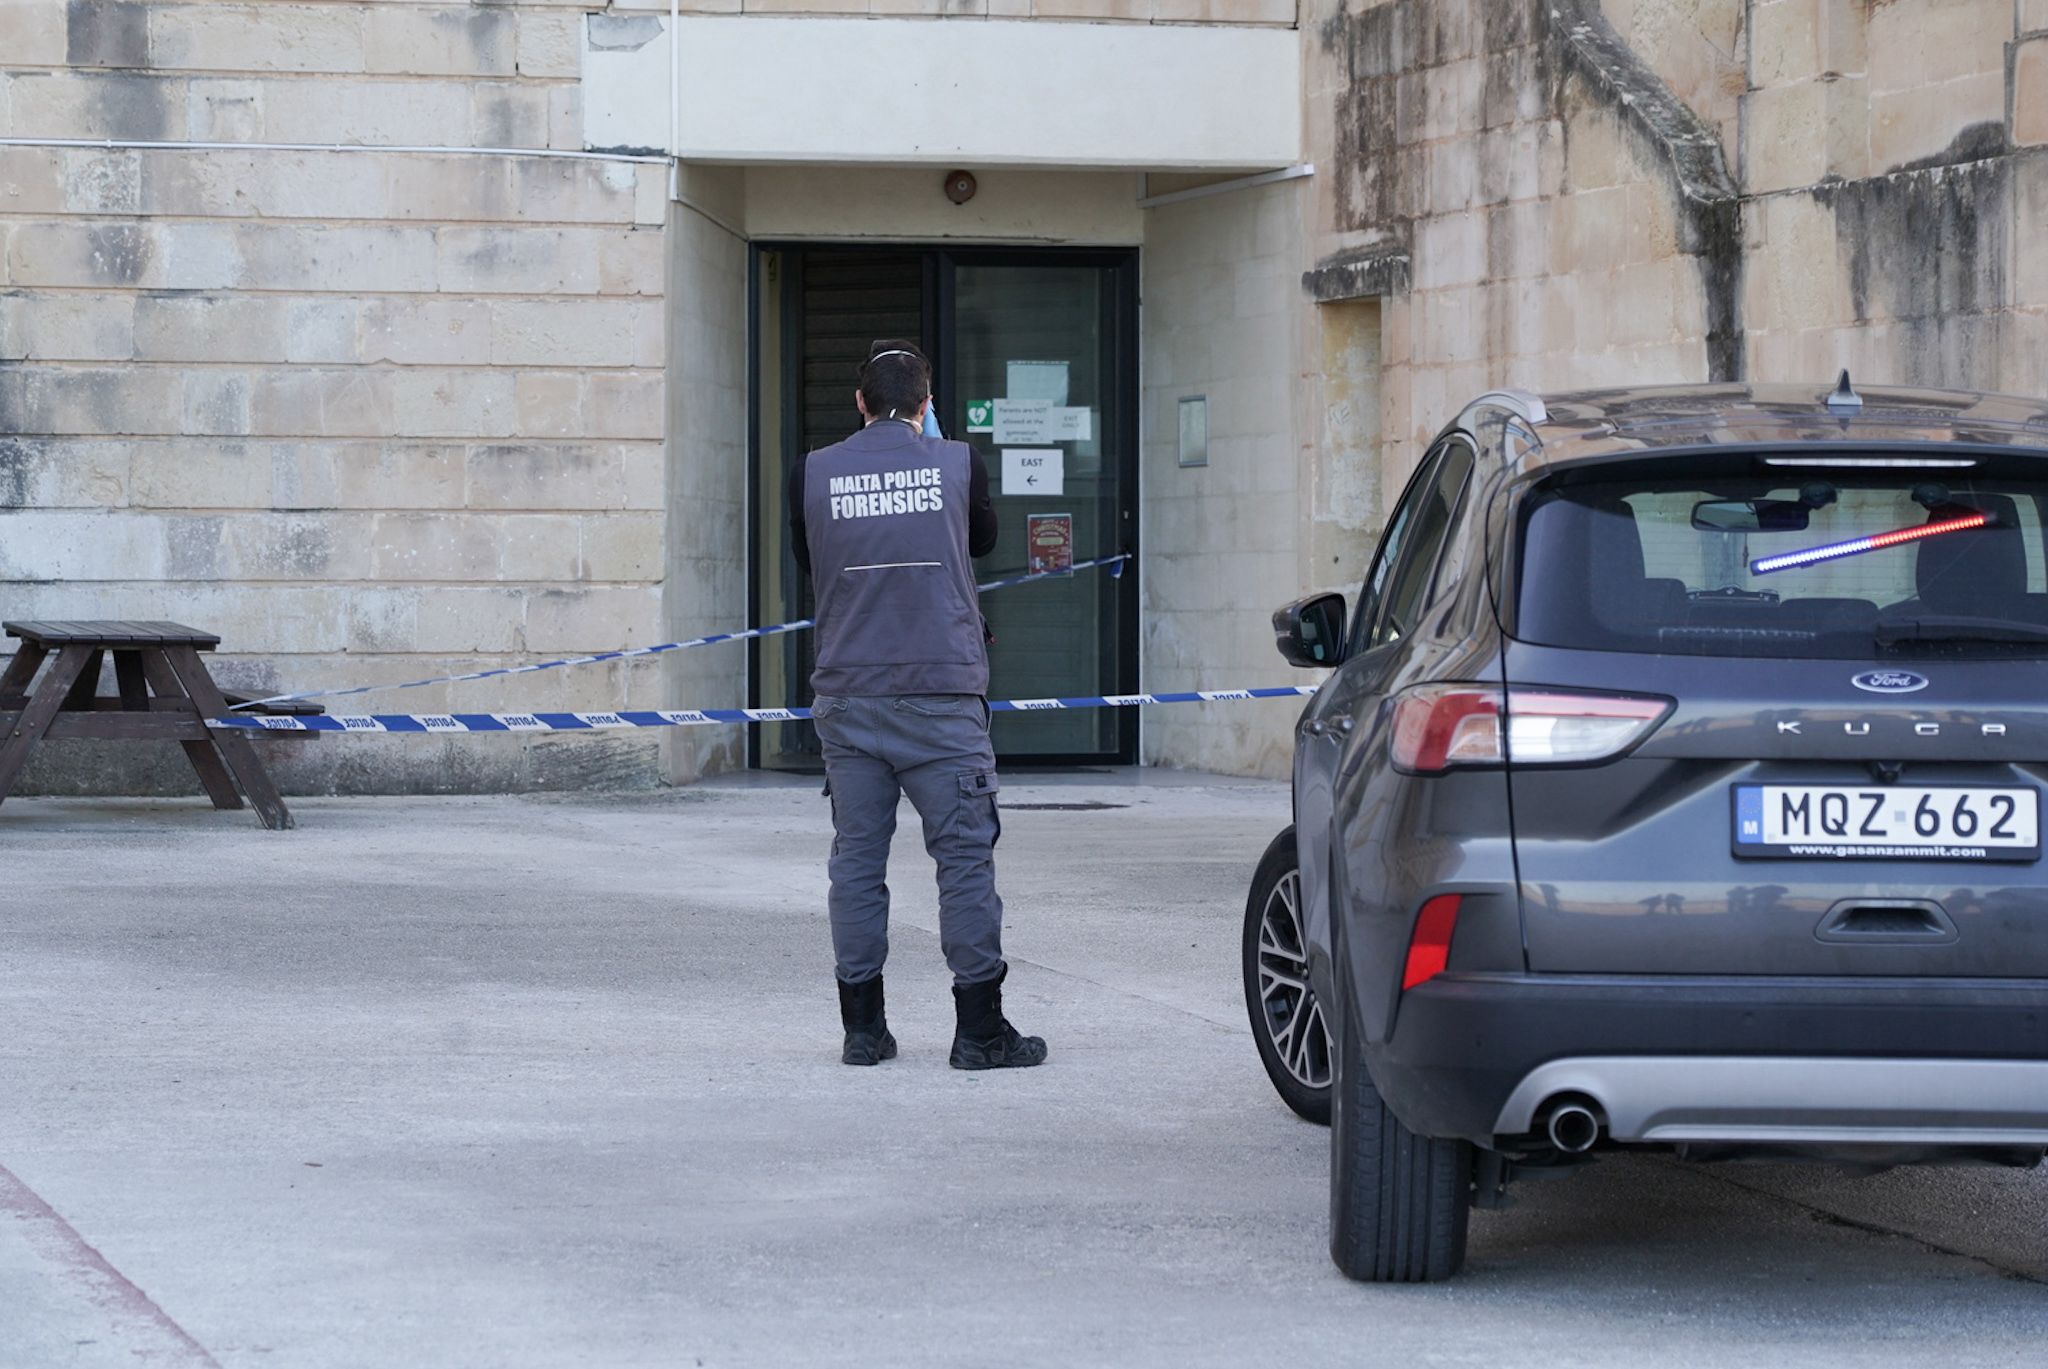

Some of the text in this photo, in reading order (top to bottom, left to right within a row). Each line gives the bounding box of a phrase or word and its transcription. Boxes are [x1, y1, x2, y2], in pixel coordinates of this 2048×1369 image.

[1021, 458, 1043, 467] EAST
[829, 468, 941, 495] MALTA POLICE
[830, 487, 943, 520] FORENSICS
[1869, 673, 1911, 689] Ford
[266, 718, 296, 729] POLICE
[344, 718, 376, 728] POLICE
[424, 717, 456, 727] POLICE
[505, 716, 538, 726] POLICE
[586, 716, 619, 724] POLICE
[670, 714, 705, 722] POLICE
[1777, 720, 2007, 737] KUGA
[1781, 791, 2016, 839] MQZ 662
[1742, 819, 1758, 835] M
[1789, 845, 1986, 857] www.gasanzammit.com
